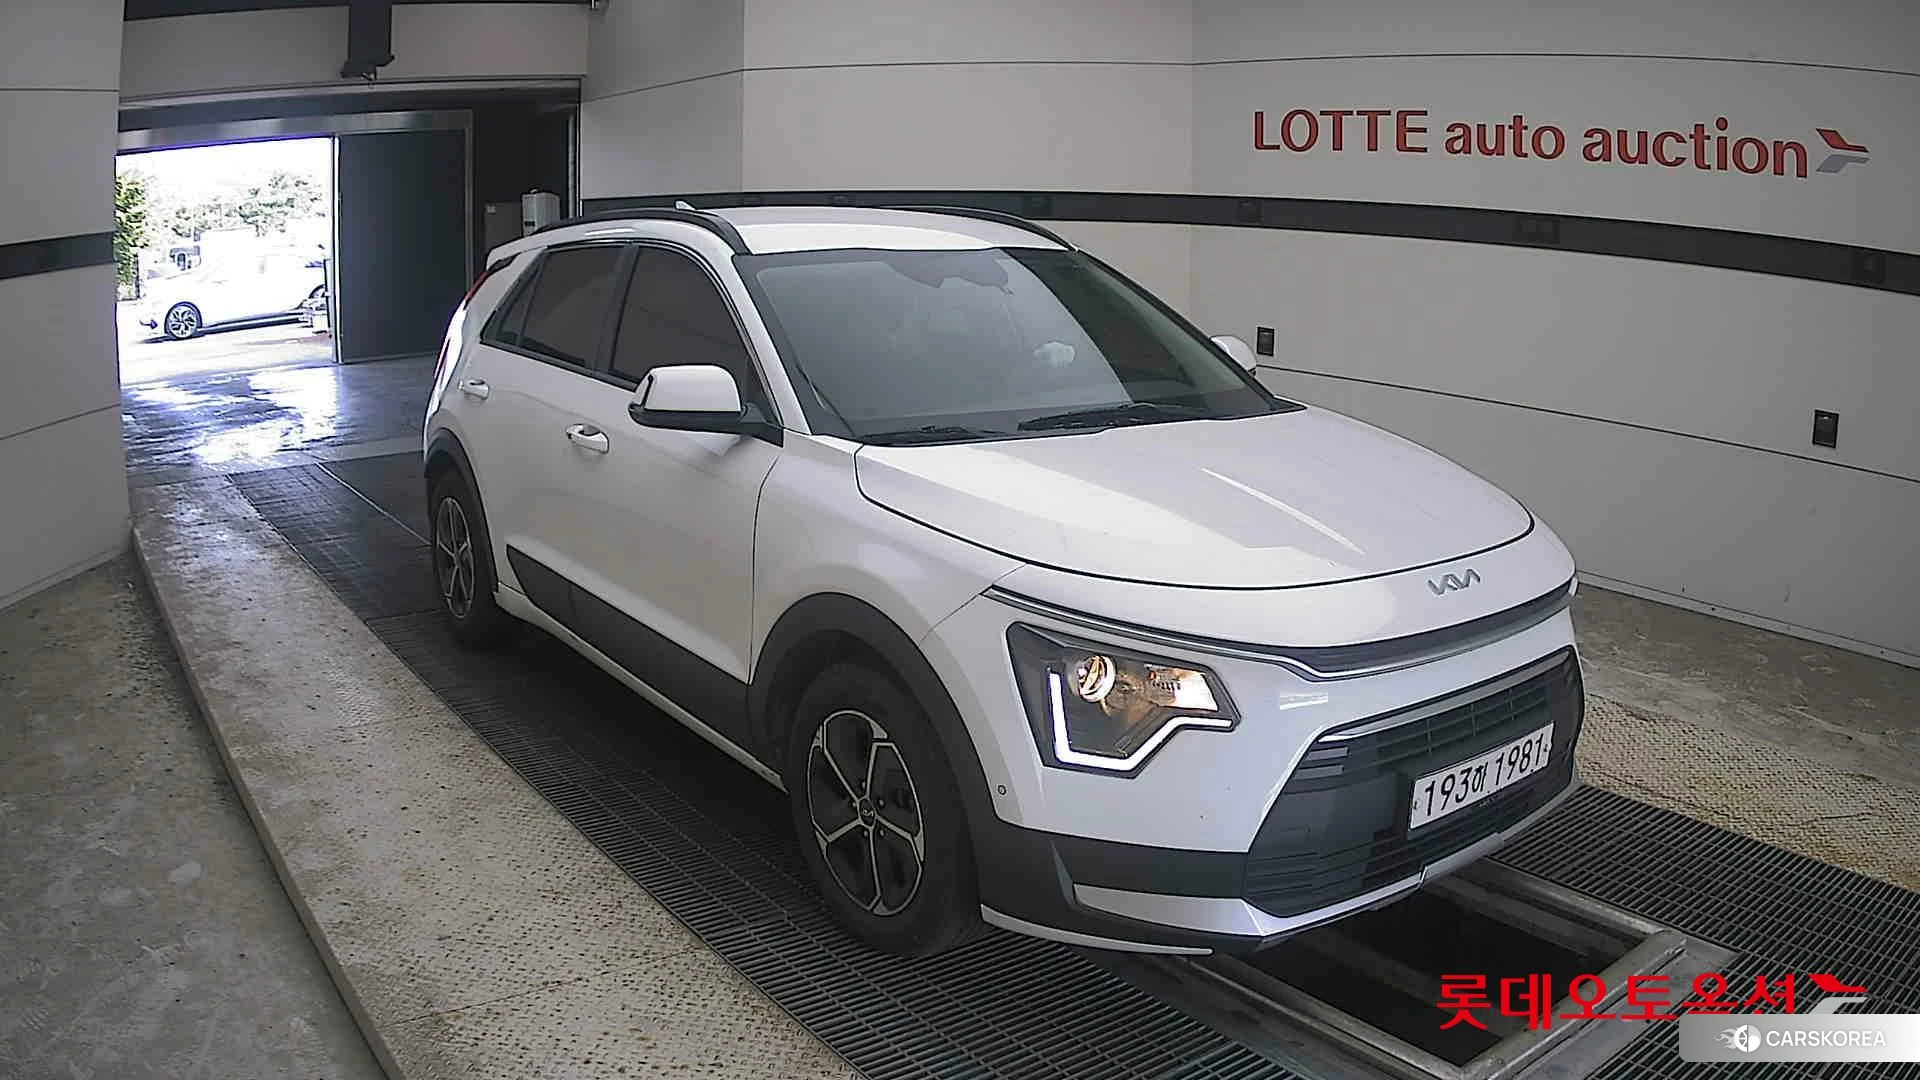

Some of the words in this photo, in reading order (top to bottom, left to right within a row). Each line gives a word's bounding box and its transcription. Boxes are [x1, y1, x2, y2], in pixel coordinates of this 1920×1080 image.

[1253, 110, 1428, 153] LOTTE
[1444, 115, 1566, 159] auto
[1582, 117, 1809, 178] auction
[1495, 733, 1545, 787] 1981
